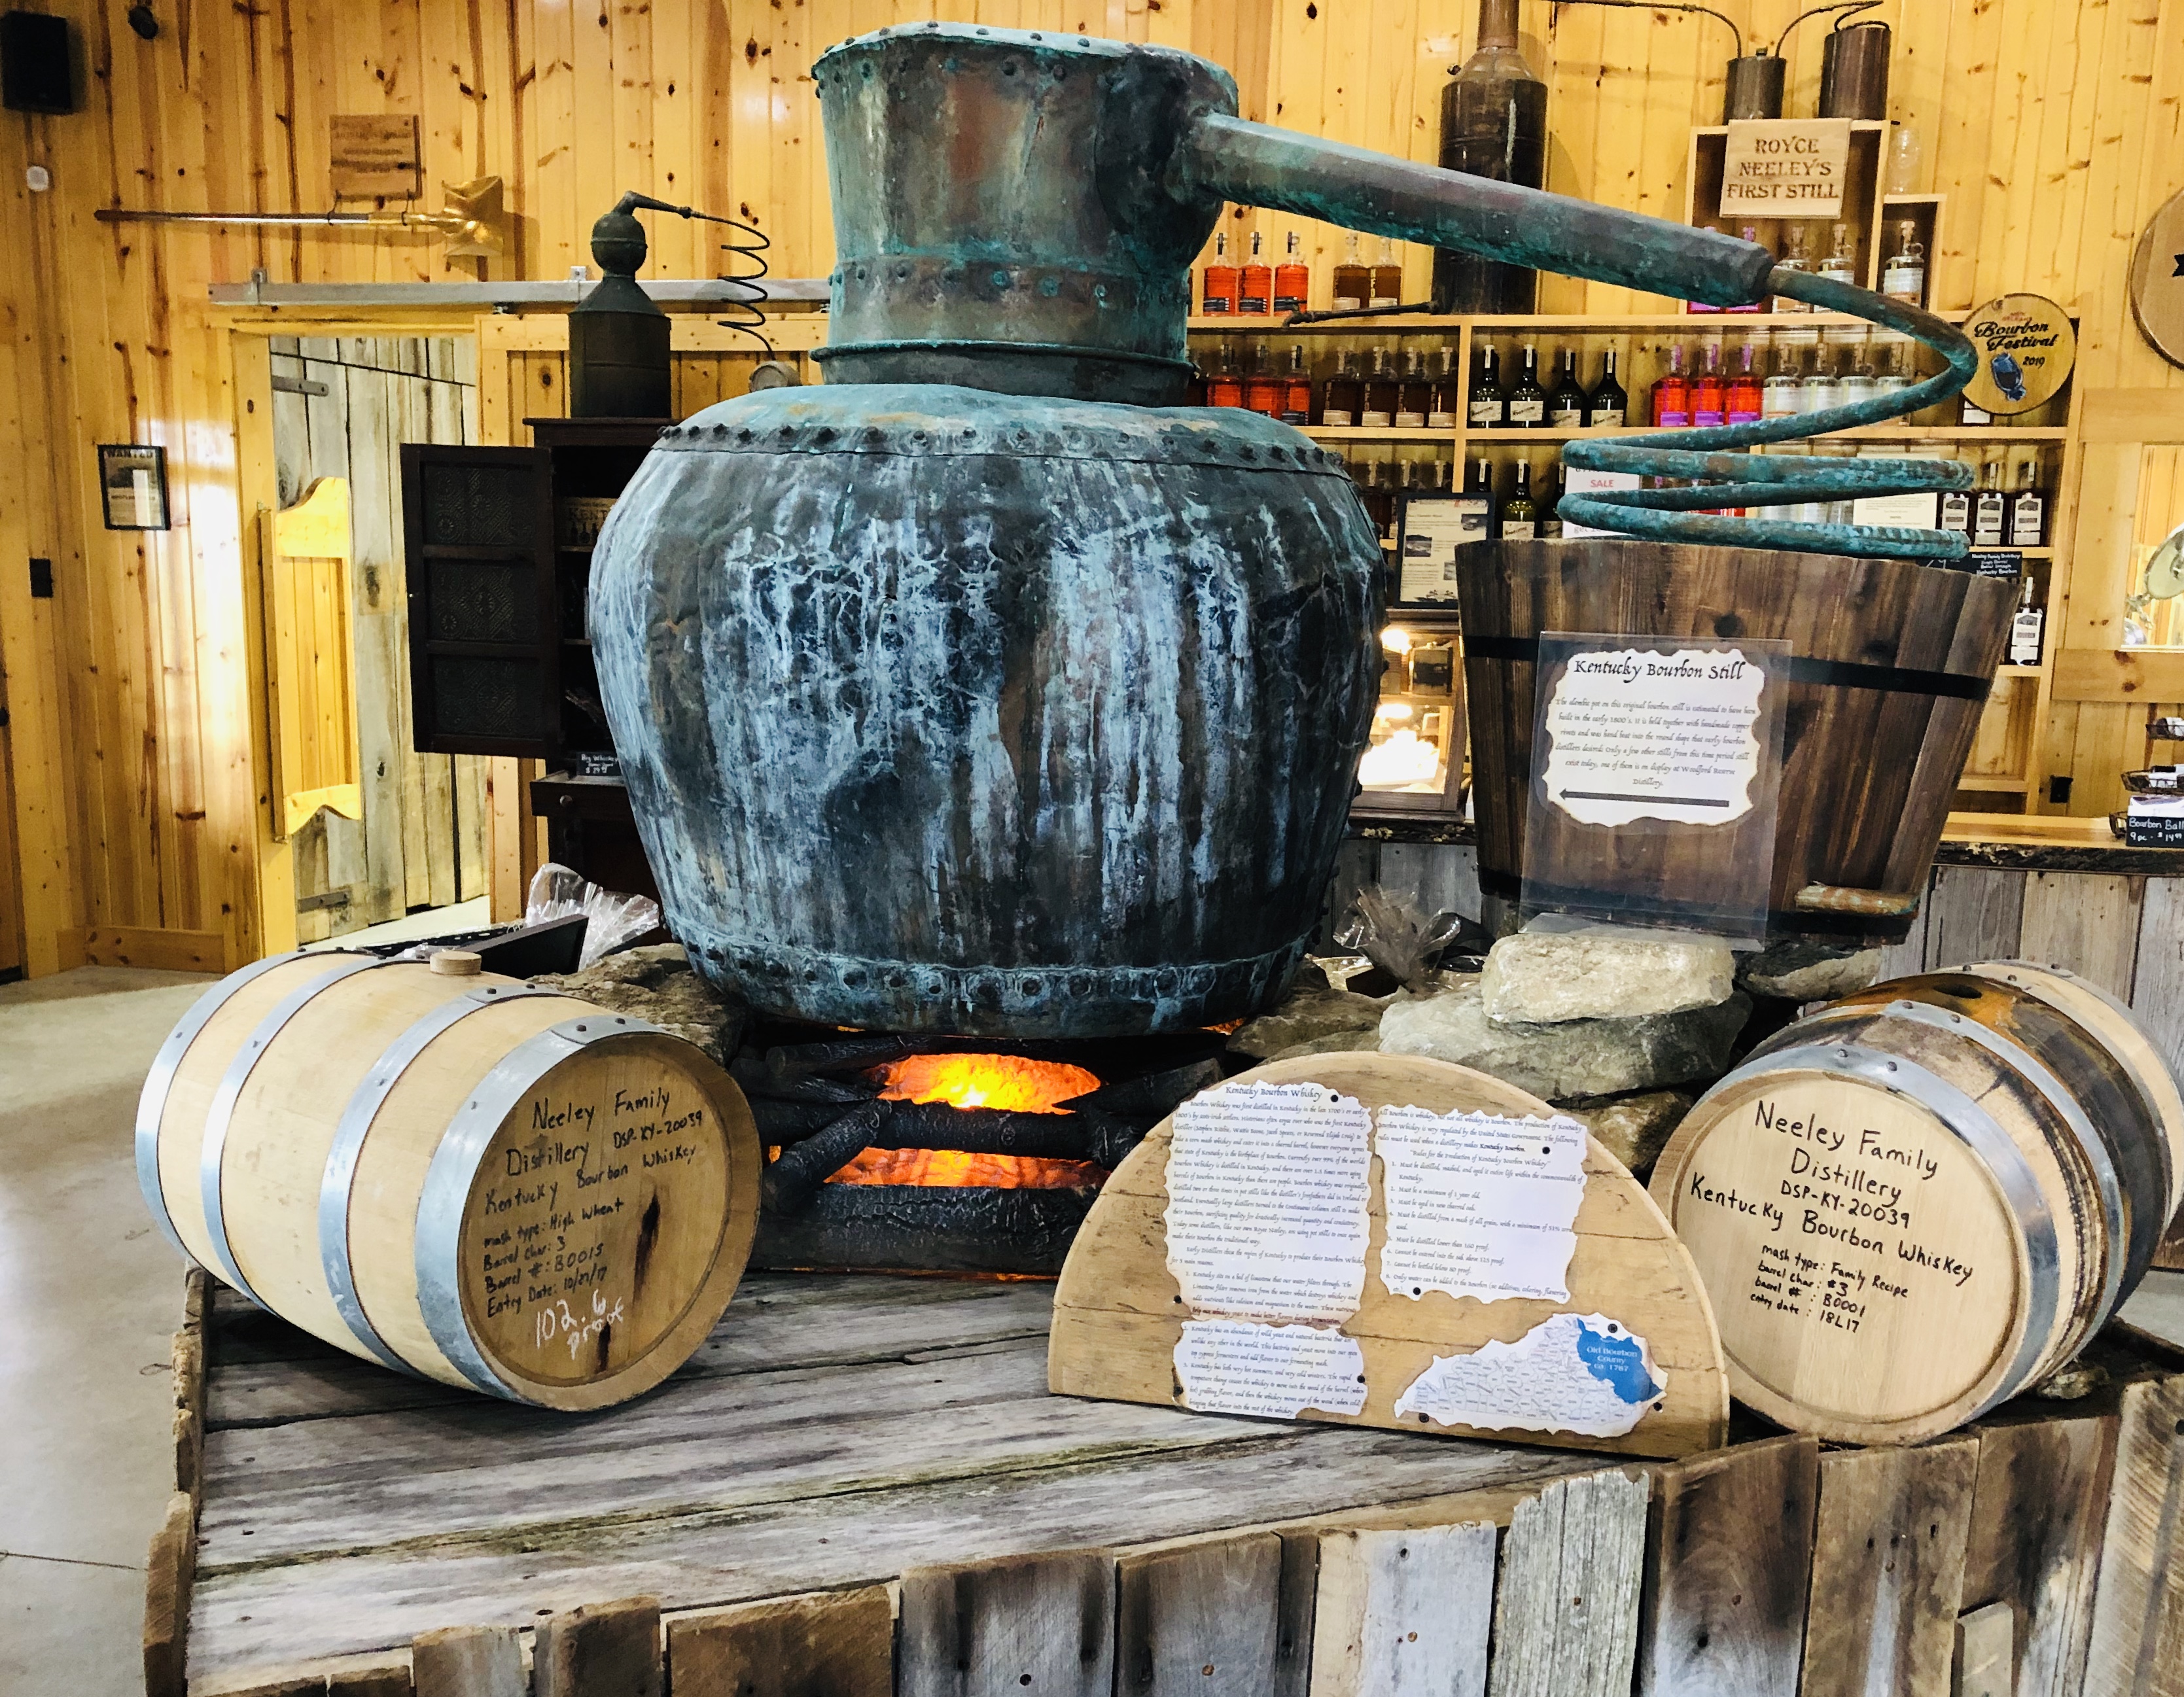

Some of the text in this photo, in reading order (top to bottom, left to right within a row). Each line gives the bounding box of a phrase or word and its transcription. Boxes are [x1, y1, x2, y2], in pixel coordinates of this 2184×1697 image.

[1755, 135, 1820, 154] ROYCE
[1739, 158, 1831, 176] NEELEY'S
[1727, 183, 1839, 198] FIRST STILL
[1975, 317, 2049, 337] Bourbon
[1987, 334, 2059, 351] Festival
[2023, 356, 2045, 369] 2019
[1574, 656, 1746, 684] Kentucky Bourbon Still
[2129, 817, 2162, 828] Bourbon
[1225, 1085, 1322, 1102] Kentucky Bourbon Whiskey
[532, 1087, 671, 1133] Neeley Family
[1755, 1100, 1938, 1181] Neeley Family
[506, 1140, 591, 1177] Distillery
[485, 1144, 697, 1216] Kentucky Bourbon Whiskey
[1791, 1147, 1901, 1208] Distillery
[550, 1215, 575, 1233] High
[582, 1198, 625, 1222] Wheat
[1691, 1172, 1973, 1287] Kentucky Bourbon Whiskey
[557, 1235, 566, 1252] 3
[1757, 1259, 1786, 1280] barrel
[1761, 1244, 1790, 1262] mash
[1831, 1261, 1866, 1291] Family
[1872, 1274, 1909, 1299] Recipe
[1755, 1276, 1782, 1295] barrel
[487, 1296, 522, 1318] Entry
[1603, 1348, 1637, 1357] Bourbon
